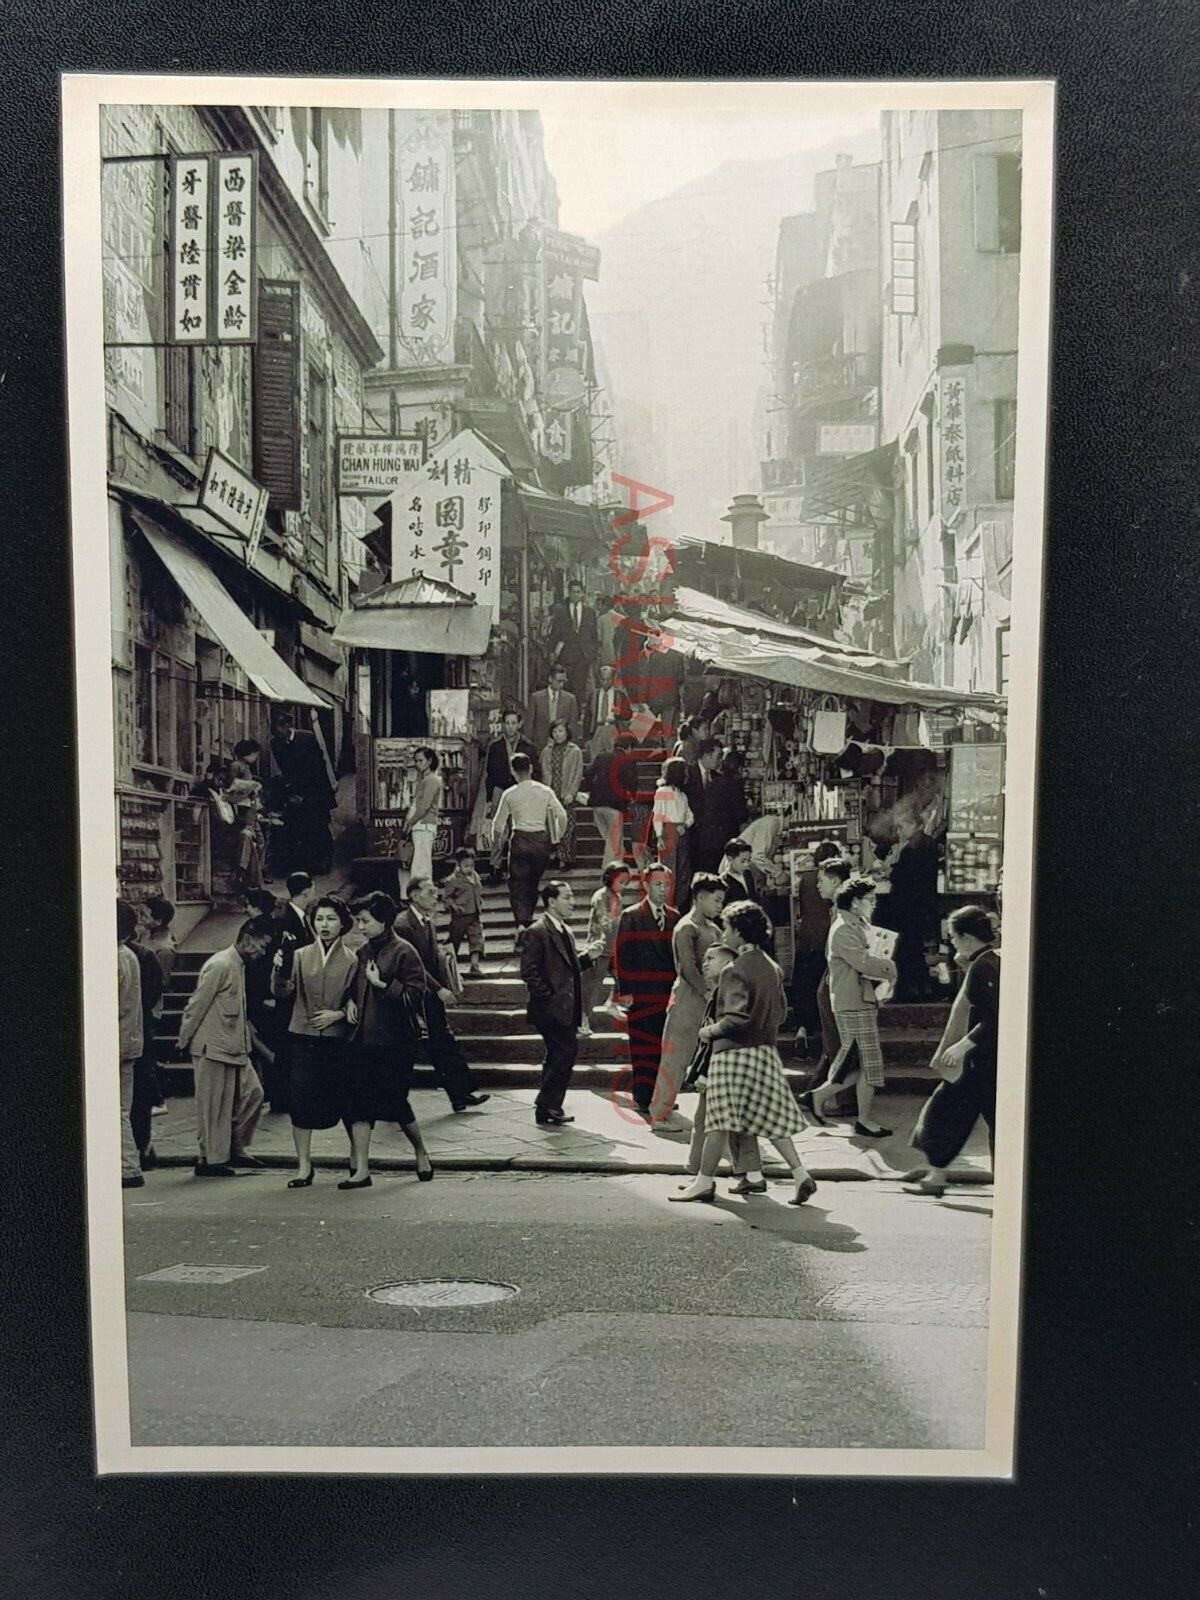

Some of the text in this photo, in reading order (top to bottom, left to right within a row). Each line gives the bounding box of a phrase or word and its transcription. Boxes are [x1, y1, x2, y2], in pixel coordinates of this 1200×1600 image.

[223, 167, 247, 330] 西醫梁金齡
[405, 157, 440, 333] 鏞記酒家
[341, 457, 420, 472] CHAN HUNG WAI
[362, 475, 399, 486] TAILOR
[374, 818, 403, 827] IVORY
